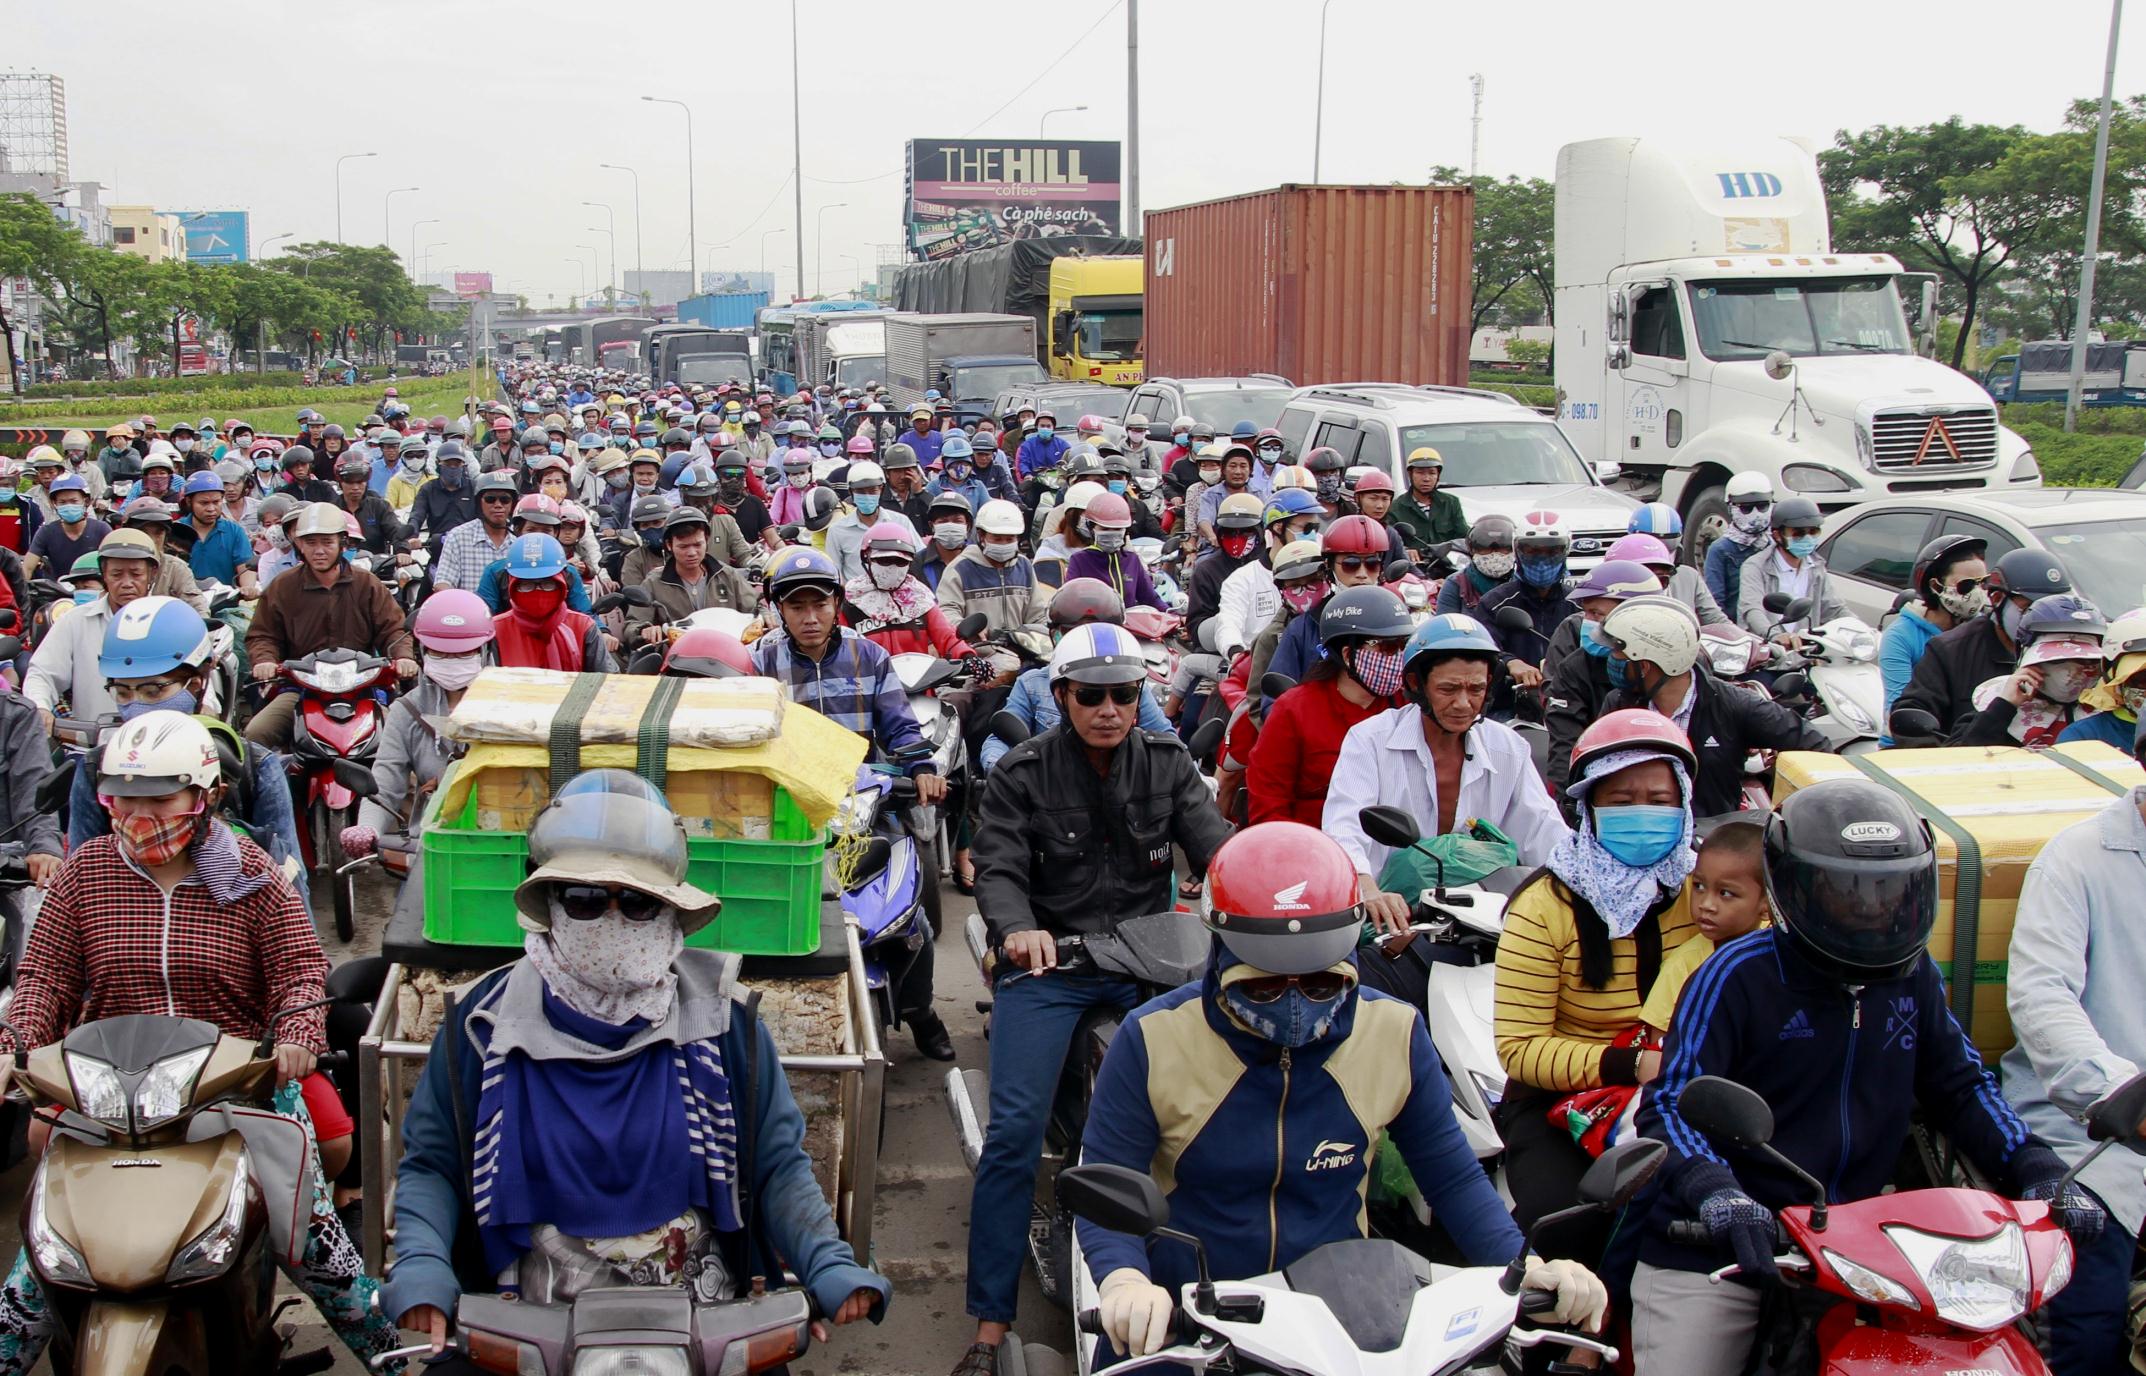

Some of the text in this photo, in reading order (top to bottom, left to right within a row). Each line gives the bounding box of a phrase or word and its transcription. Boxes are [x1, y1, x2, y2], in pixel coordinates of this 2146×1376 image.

[995, 182, 1038, 197] coffee
[1715, 172, 1782, 198] HD
[1002, 206, 1089, 225] Cà phê sạch
[1115, 373, 1129, 382] AN
[1572, 402, 1598, 420] 098.70
[1634, 405, 1659, 420] HD
[1576, 540, 1596, 549] Ford
[1333, 607, 1344, 619] My
[1345, 606, 1363, 616] Bike
[1850, 826, 1891, 836] LUCKY
[1273, 903, 1312, 911] HONDA
[1899, 997, 1914, 1012] M
[1779, 1027, 1815, 1040] adidas
[1900, 1034, 1913, 1050] C
[112, 1159, 161, 1167] HONDA
[1305, 1153, 1355, 1171] LI-NING
[1456, 1311, 1478, 1325] FI
